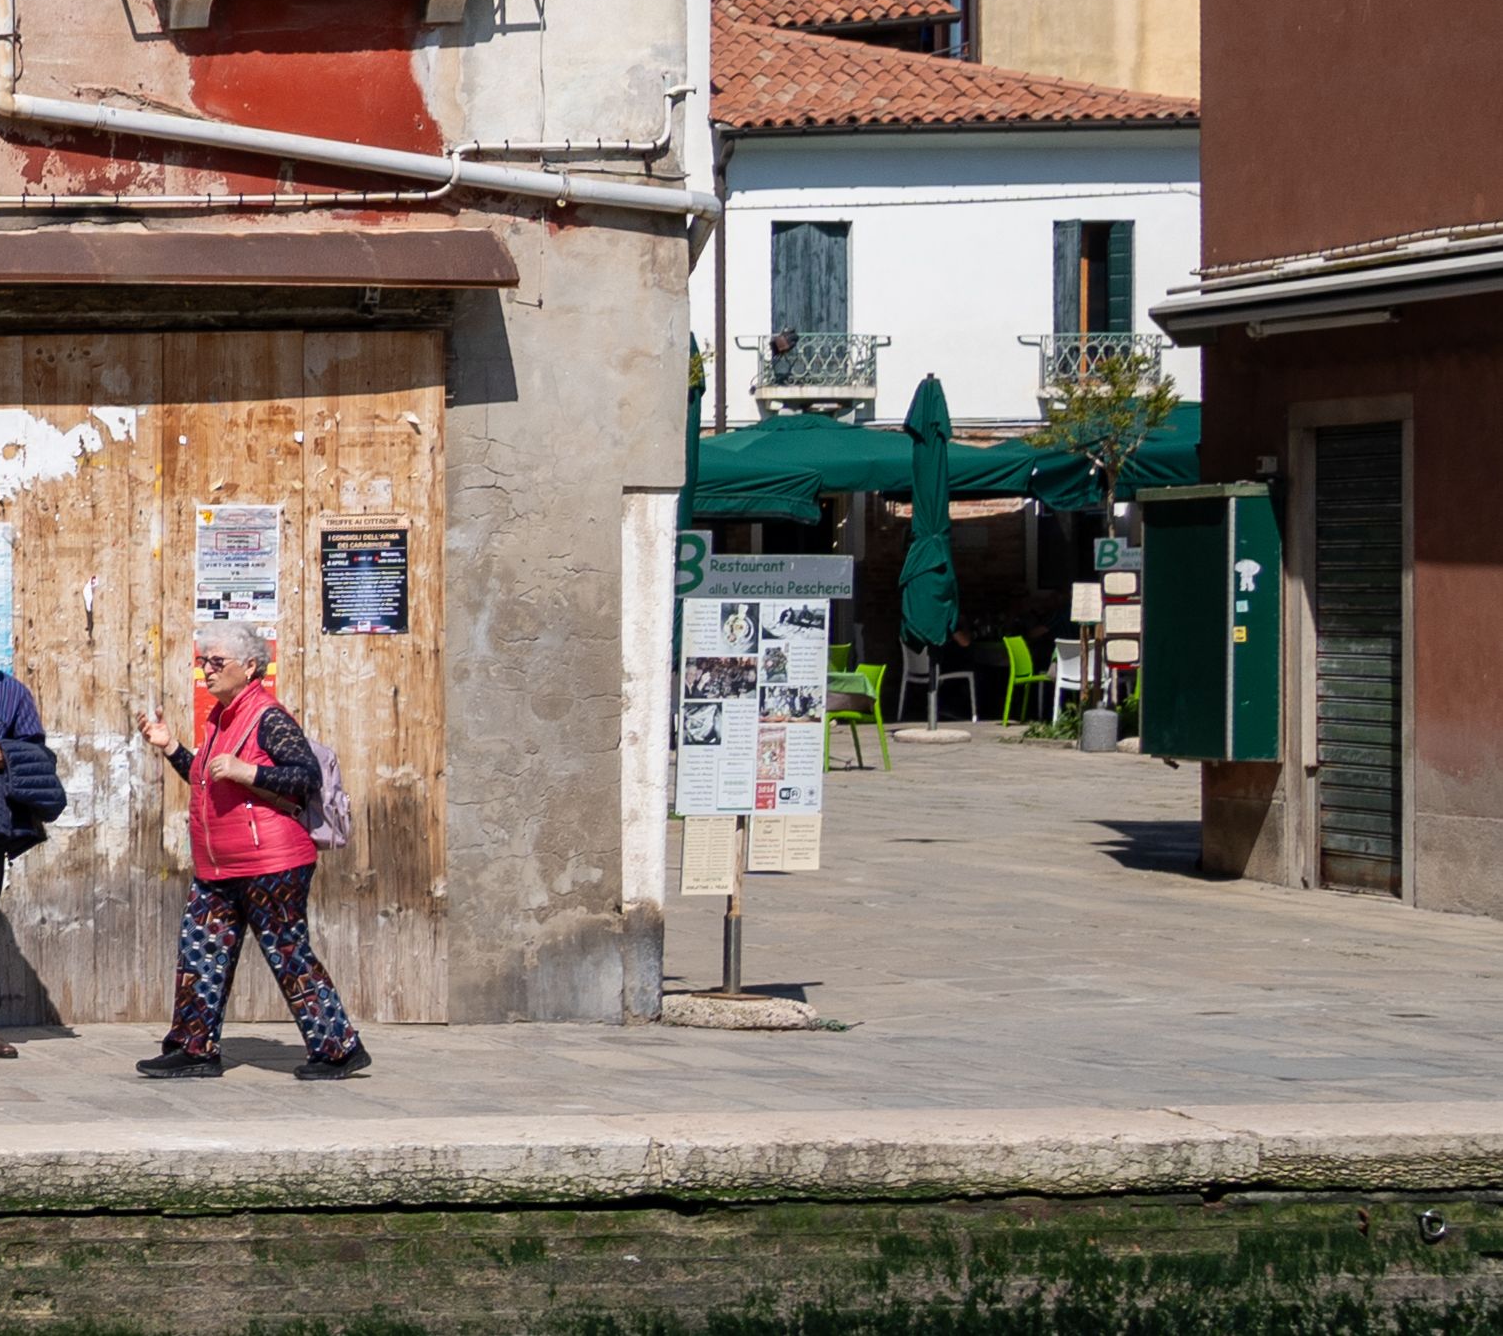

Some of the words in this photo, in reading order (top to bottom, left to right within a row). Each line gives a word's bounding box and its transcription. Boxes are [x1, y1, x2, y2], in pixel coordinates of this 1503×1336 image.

[1097, 539, 1119, 569] B
[709, 559, 786, 573] Restaurant
[709, 583, 728, 595] alla
[732, 582, 784, 595] Vecchia
[787, 582, 851, 595] Pescheria
